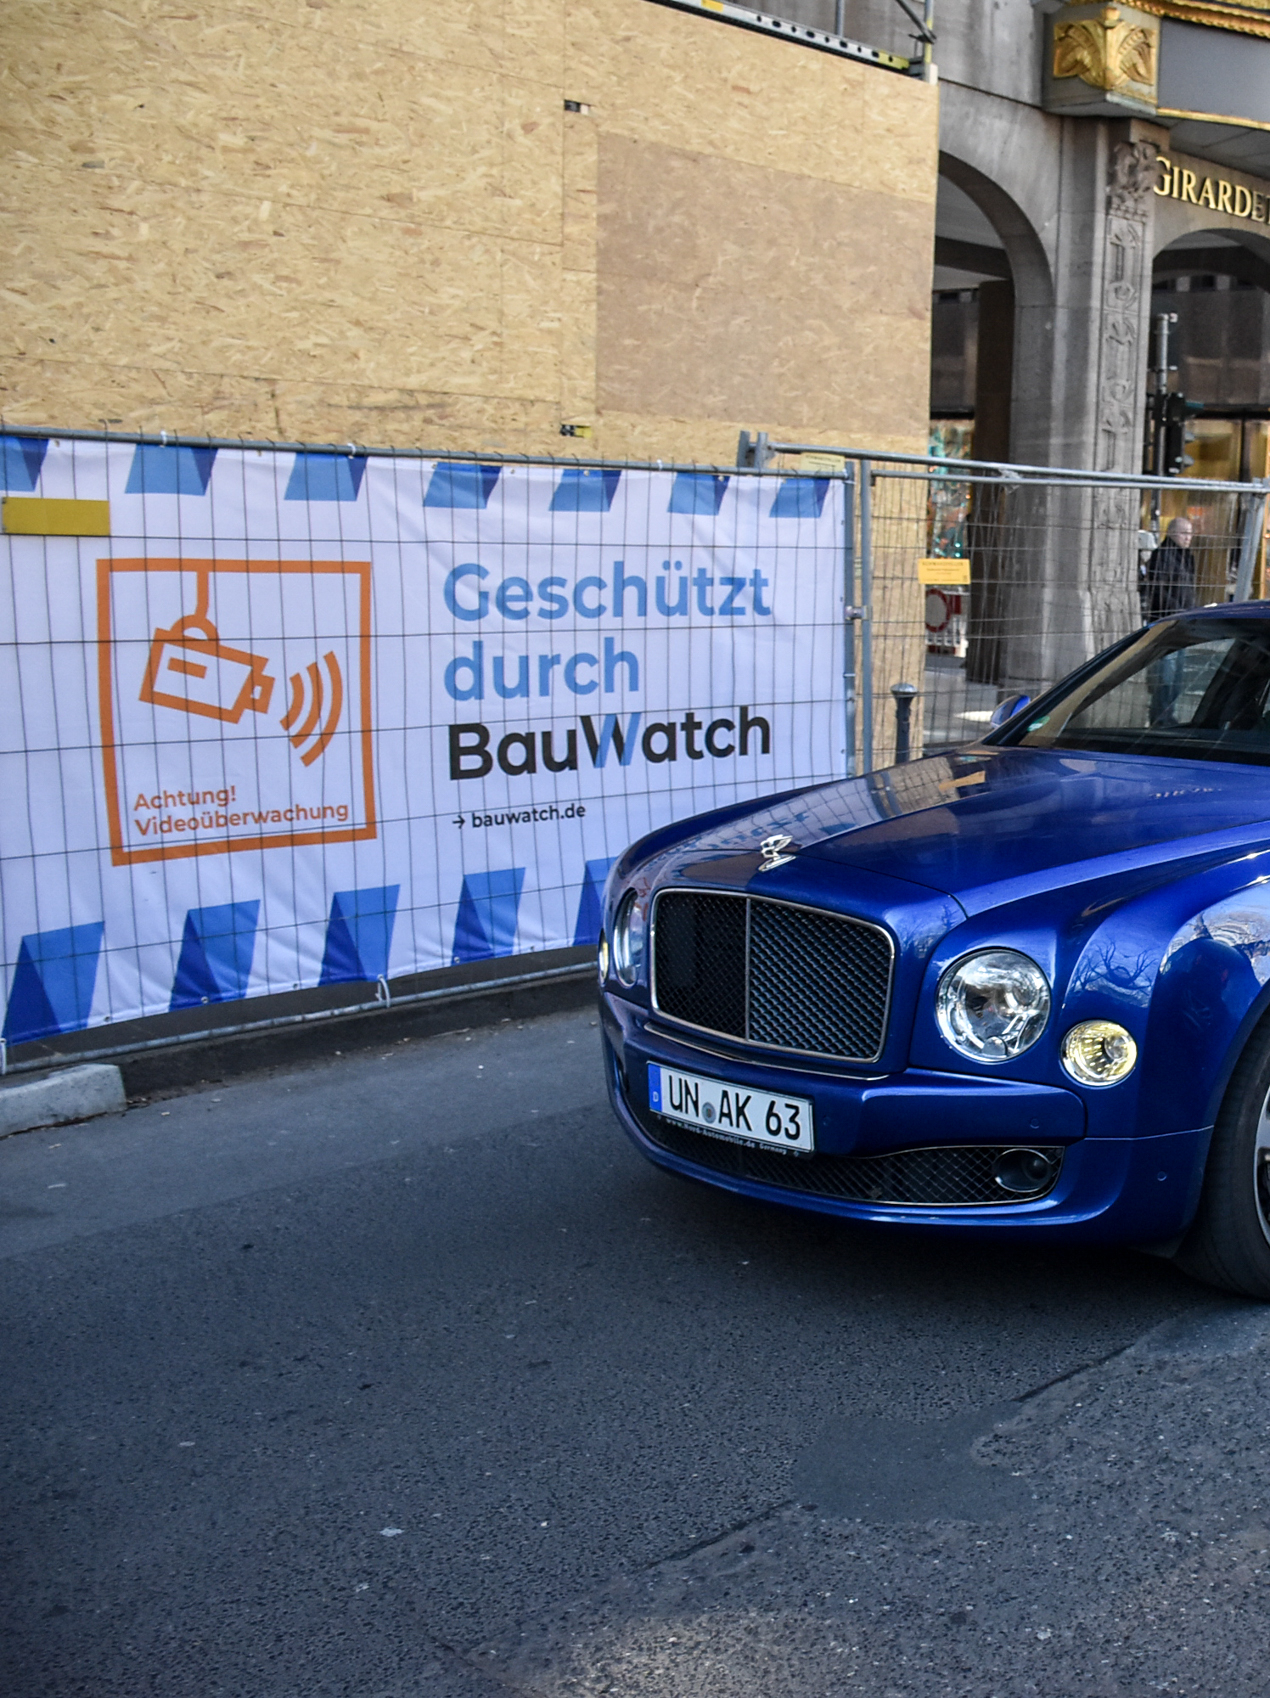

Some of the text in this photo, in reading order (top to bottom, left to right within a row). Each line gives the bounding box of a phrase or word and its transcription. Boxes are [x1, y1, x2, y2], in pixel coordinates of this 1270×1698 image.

[443, 560, 772, 622] Geschützt
[443, 636, 640, 702] durch
[448, 705, 771, 781] BauWatch
[133, 785, 237, 812] Achtung!
[133, 804, 349, 836] Videoüberwachung
[471, 803, 587, 829] bauwatch.de
[668, 1075, 801, 1141] UN AK 63
